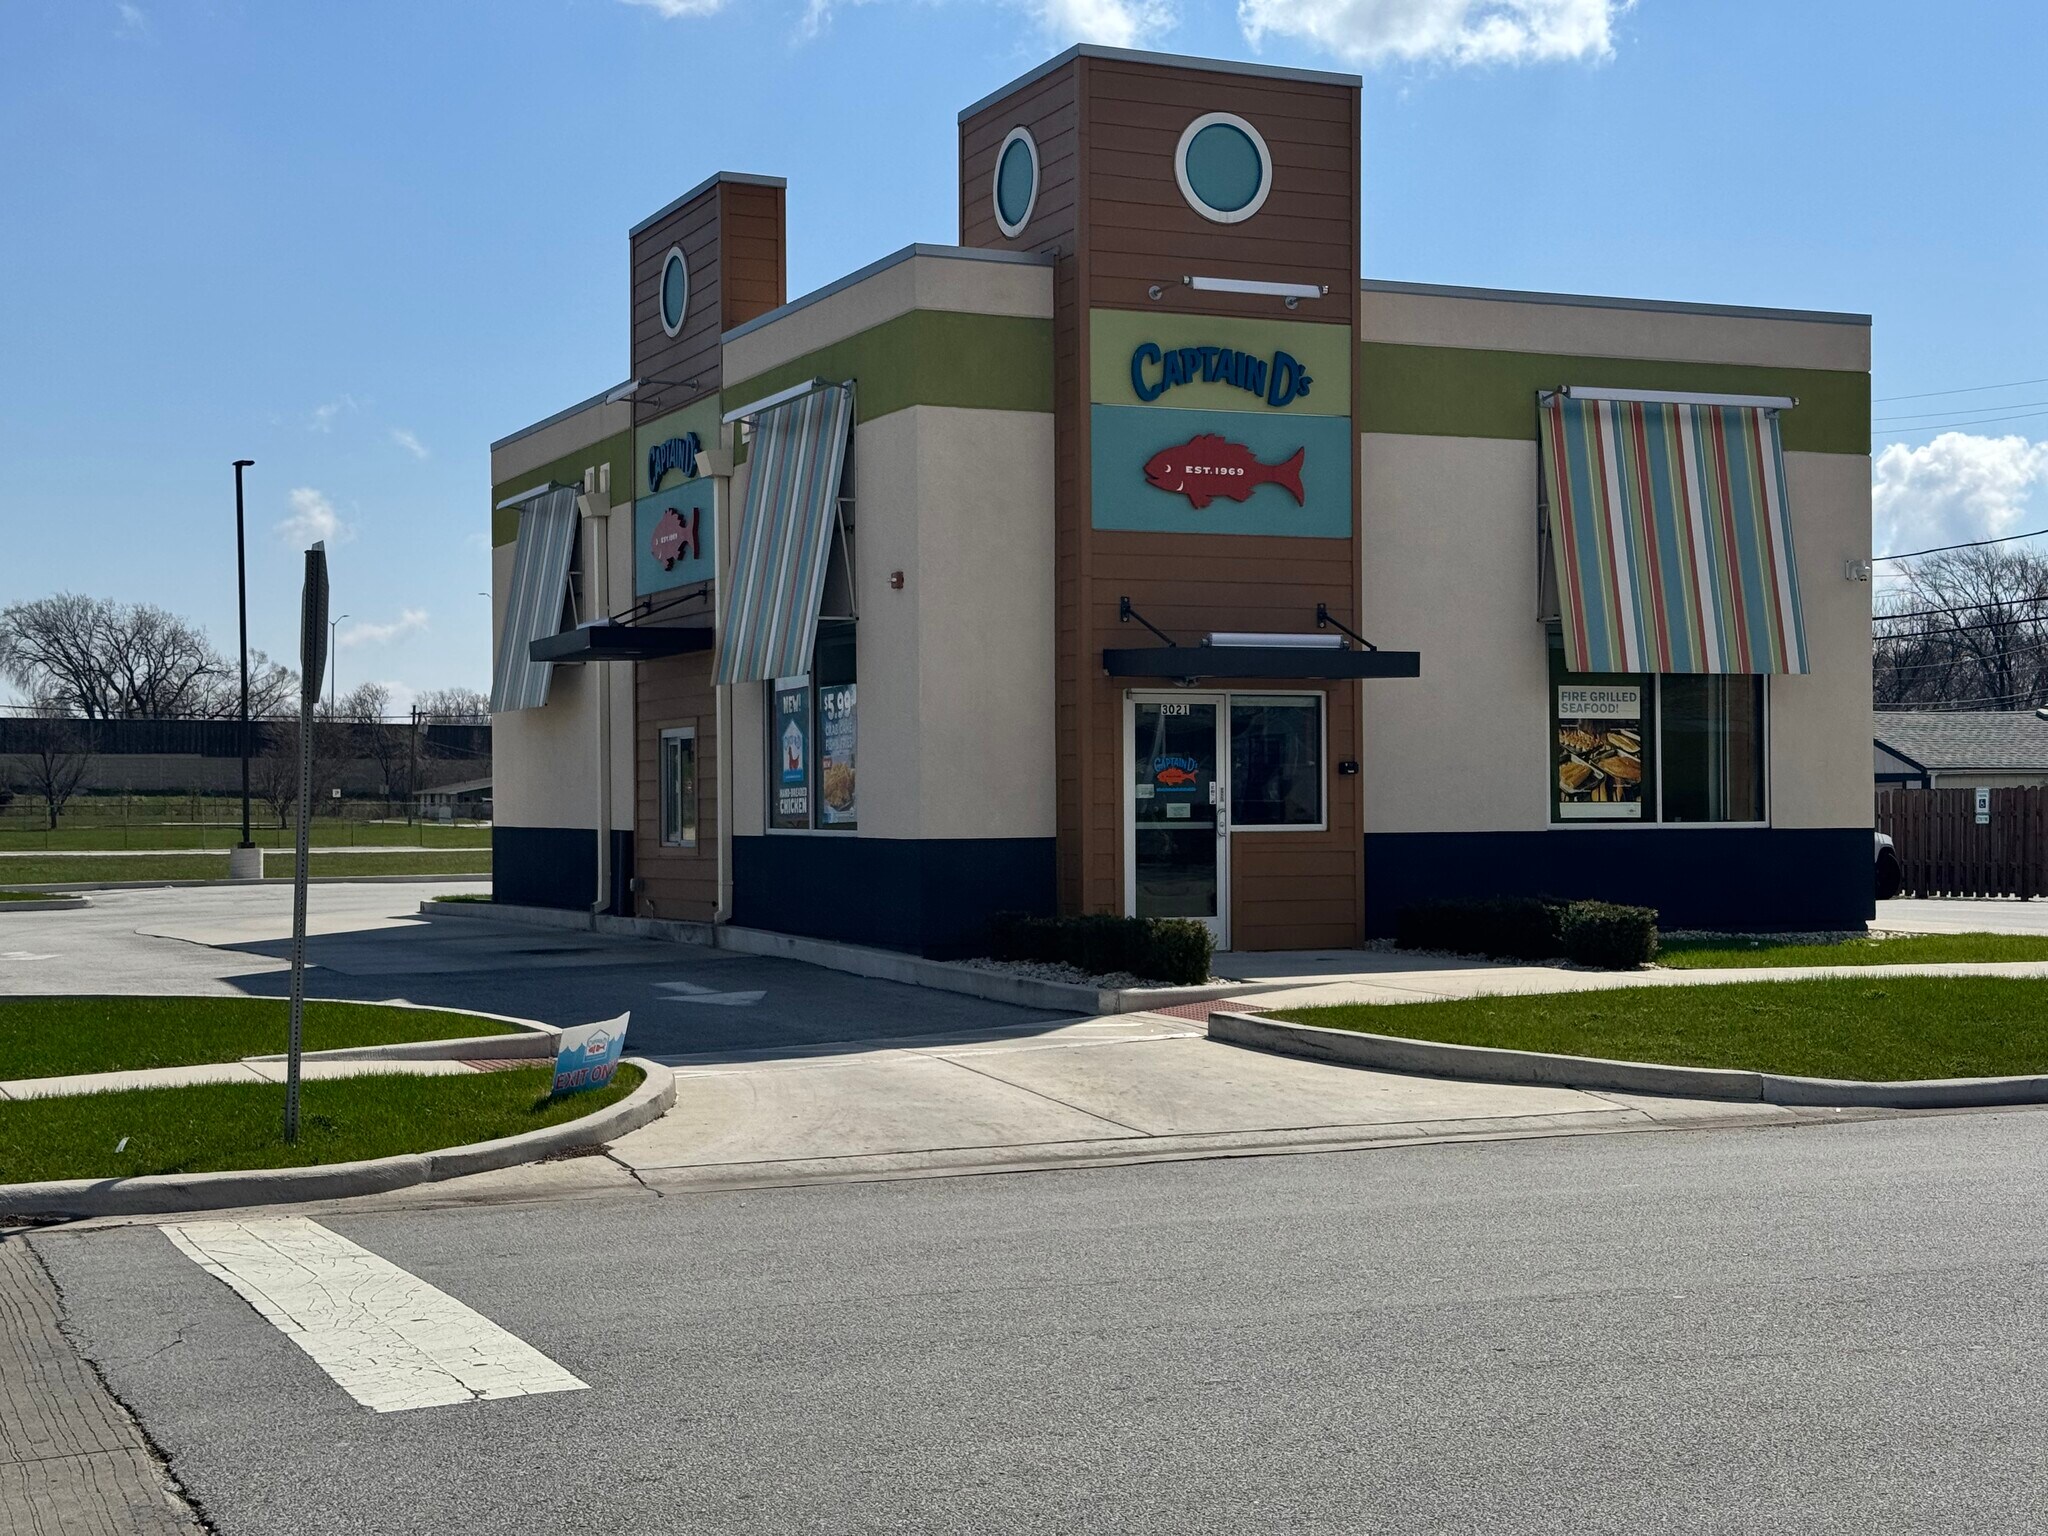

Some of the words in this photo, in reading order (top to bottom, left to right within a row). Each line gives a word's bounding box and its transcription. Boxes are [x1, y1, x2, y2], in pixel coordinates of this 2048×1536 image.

[1131, 342, 1268, 402] CAPTAIN
[648, 437, 686, 492] CAPTAIN
[783, 693, 801, 714] NEW!
[824, 690, 851, 720] $5.99
[1561, 691, 1587, 702] FIRE
[1590, 691, 1637, 703] GRILLED
[1162, 704, 1188, 715] 3021
[1561, 703, 1619, 714] SEAFOOD!
[1154, 756, 1187, 773] CAPTAIN
[779, 797, 807, 815] CHICKEN
[555, 1068, 589, 1091] EXIT
